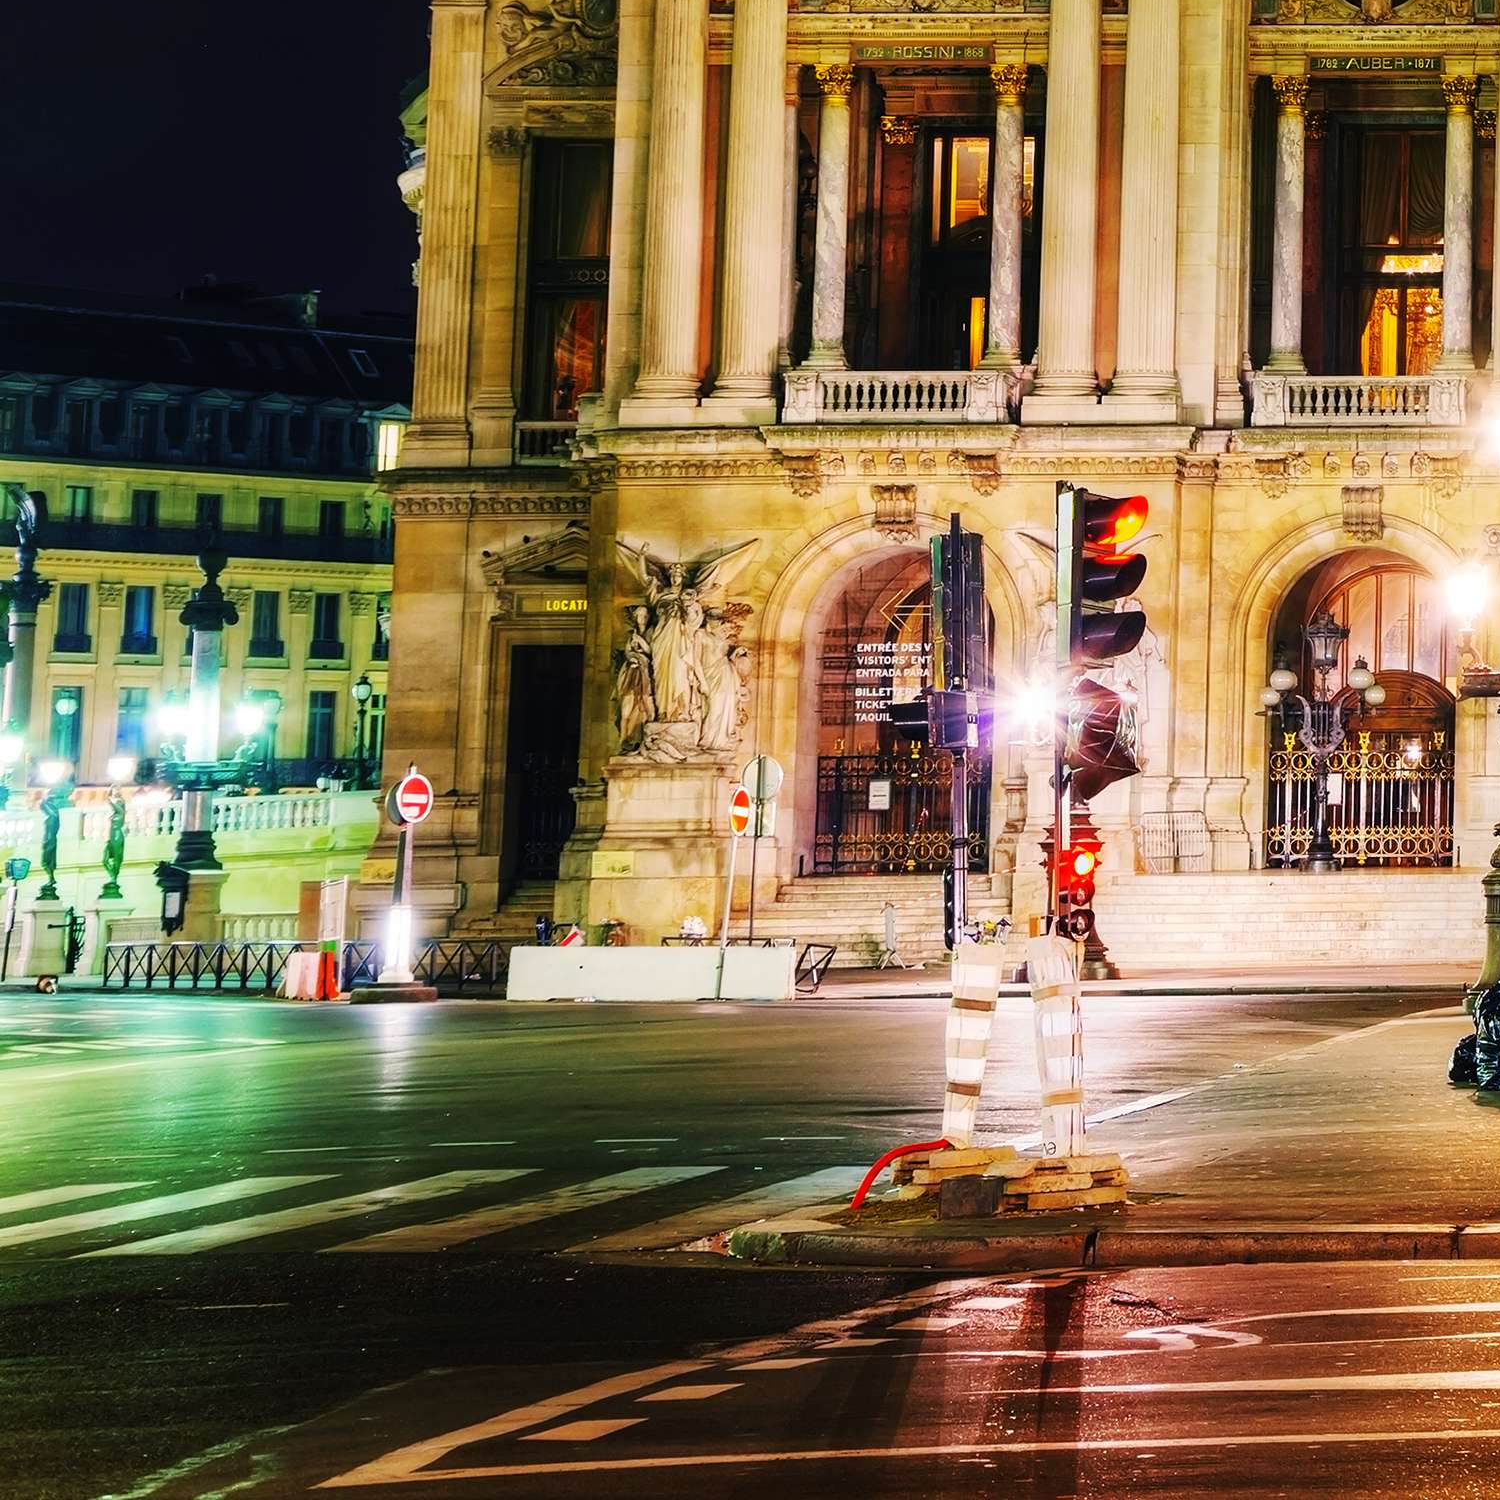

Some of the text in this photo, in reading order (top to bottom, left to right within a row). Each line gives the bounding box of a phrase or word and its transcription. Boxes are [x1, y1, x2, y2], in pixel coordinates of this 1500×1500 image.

[892, 45, 955, 59] ROSSINI
[1345, 57, 1405, 69] AUBER
[1414, 58, 1434, 69] 1871
[546, 599, 588, 611] LOCATI
[857, 641, 899, 653] ENTRÉE
[901, 644, 921, 652] DES
[856, 668, 931, 678] ENTRADA PARA
